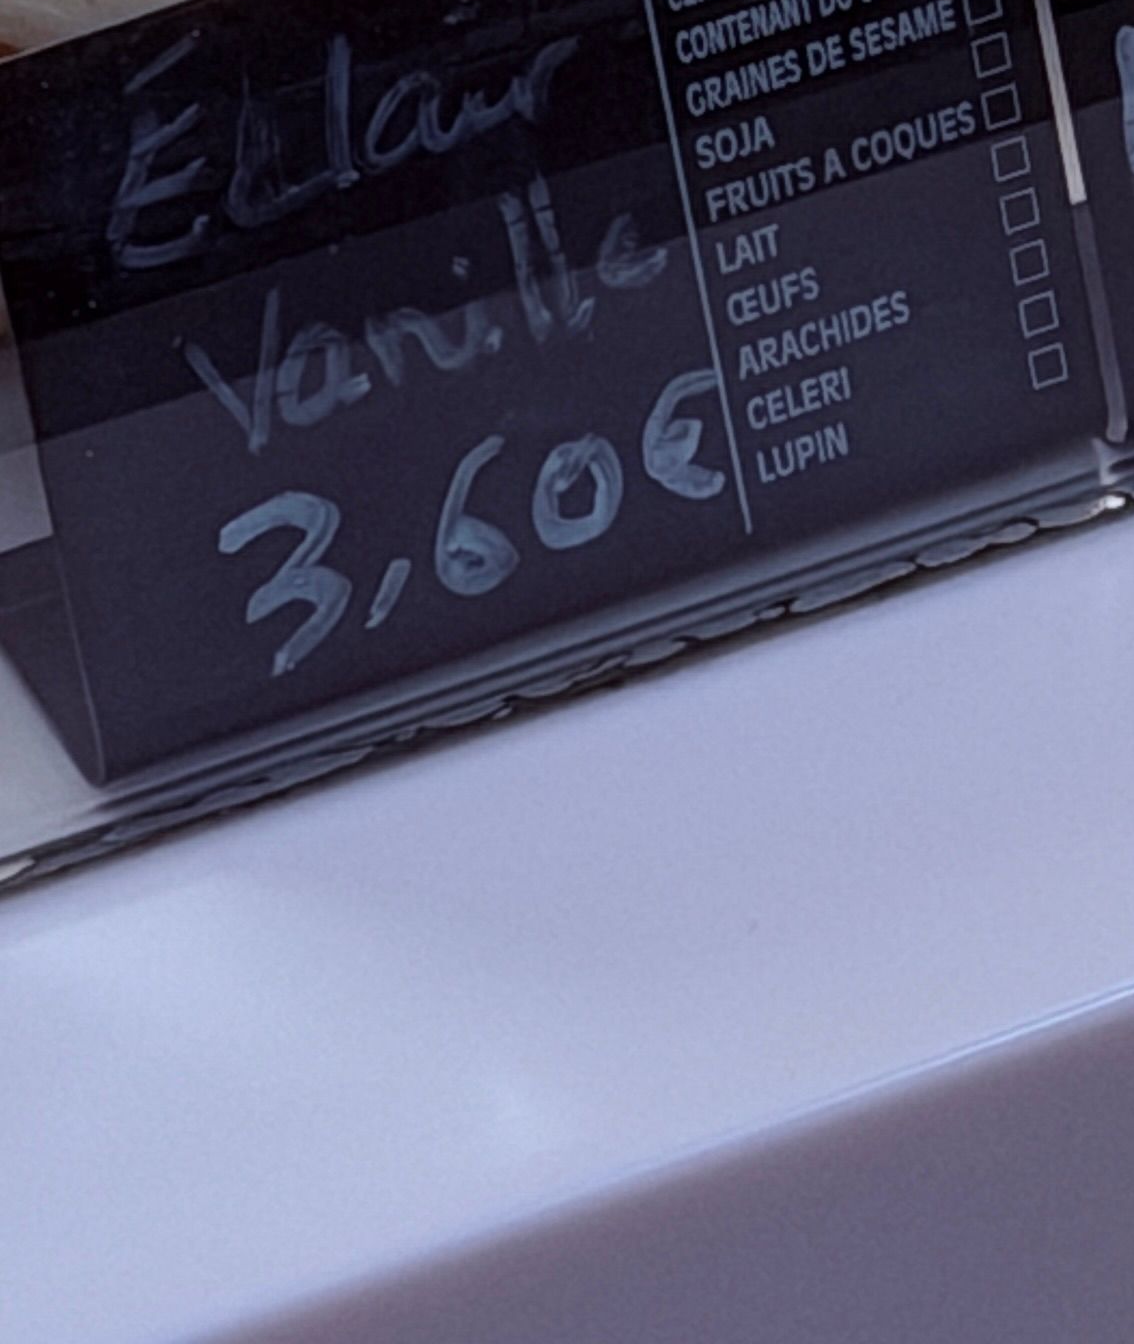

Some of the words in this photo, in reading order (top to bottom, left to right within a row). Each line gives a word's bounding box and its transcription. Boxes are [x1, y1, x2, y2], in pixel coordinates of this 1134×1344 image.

[686, 50, 802, 117] GRAINES
[806, 39, 846, 78] DE
[695, 116, 775, 169] SOJA
[705, 156, 816, 222] FRUITS
[823, 147, 848, 184] A
[851, 101, 976, 170] COQUES
[716, 223, 779, 275] LAIT
[726, 266, 820, 326] ŒUFS
[737, 291, 911, 381] ARACHIDES
[746, 367, 852, 430] CELERI
[756, 421, 849, 483] LUPIN
